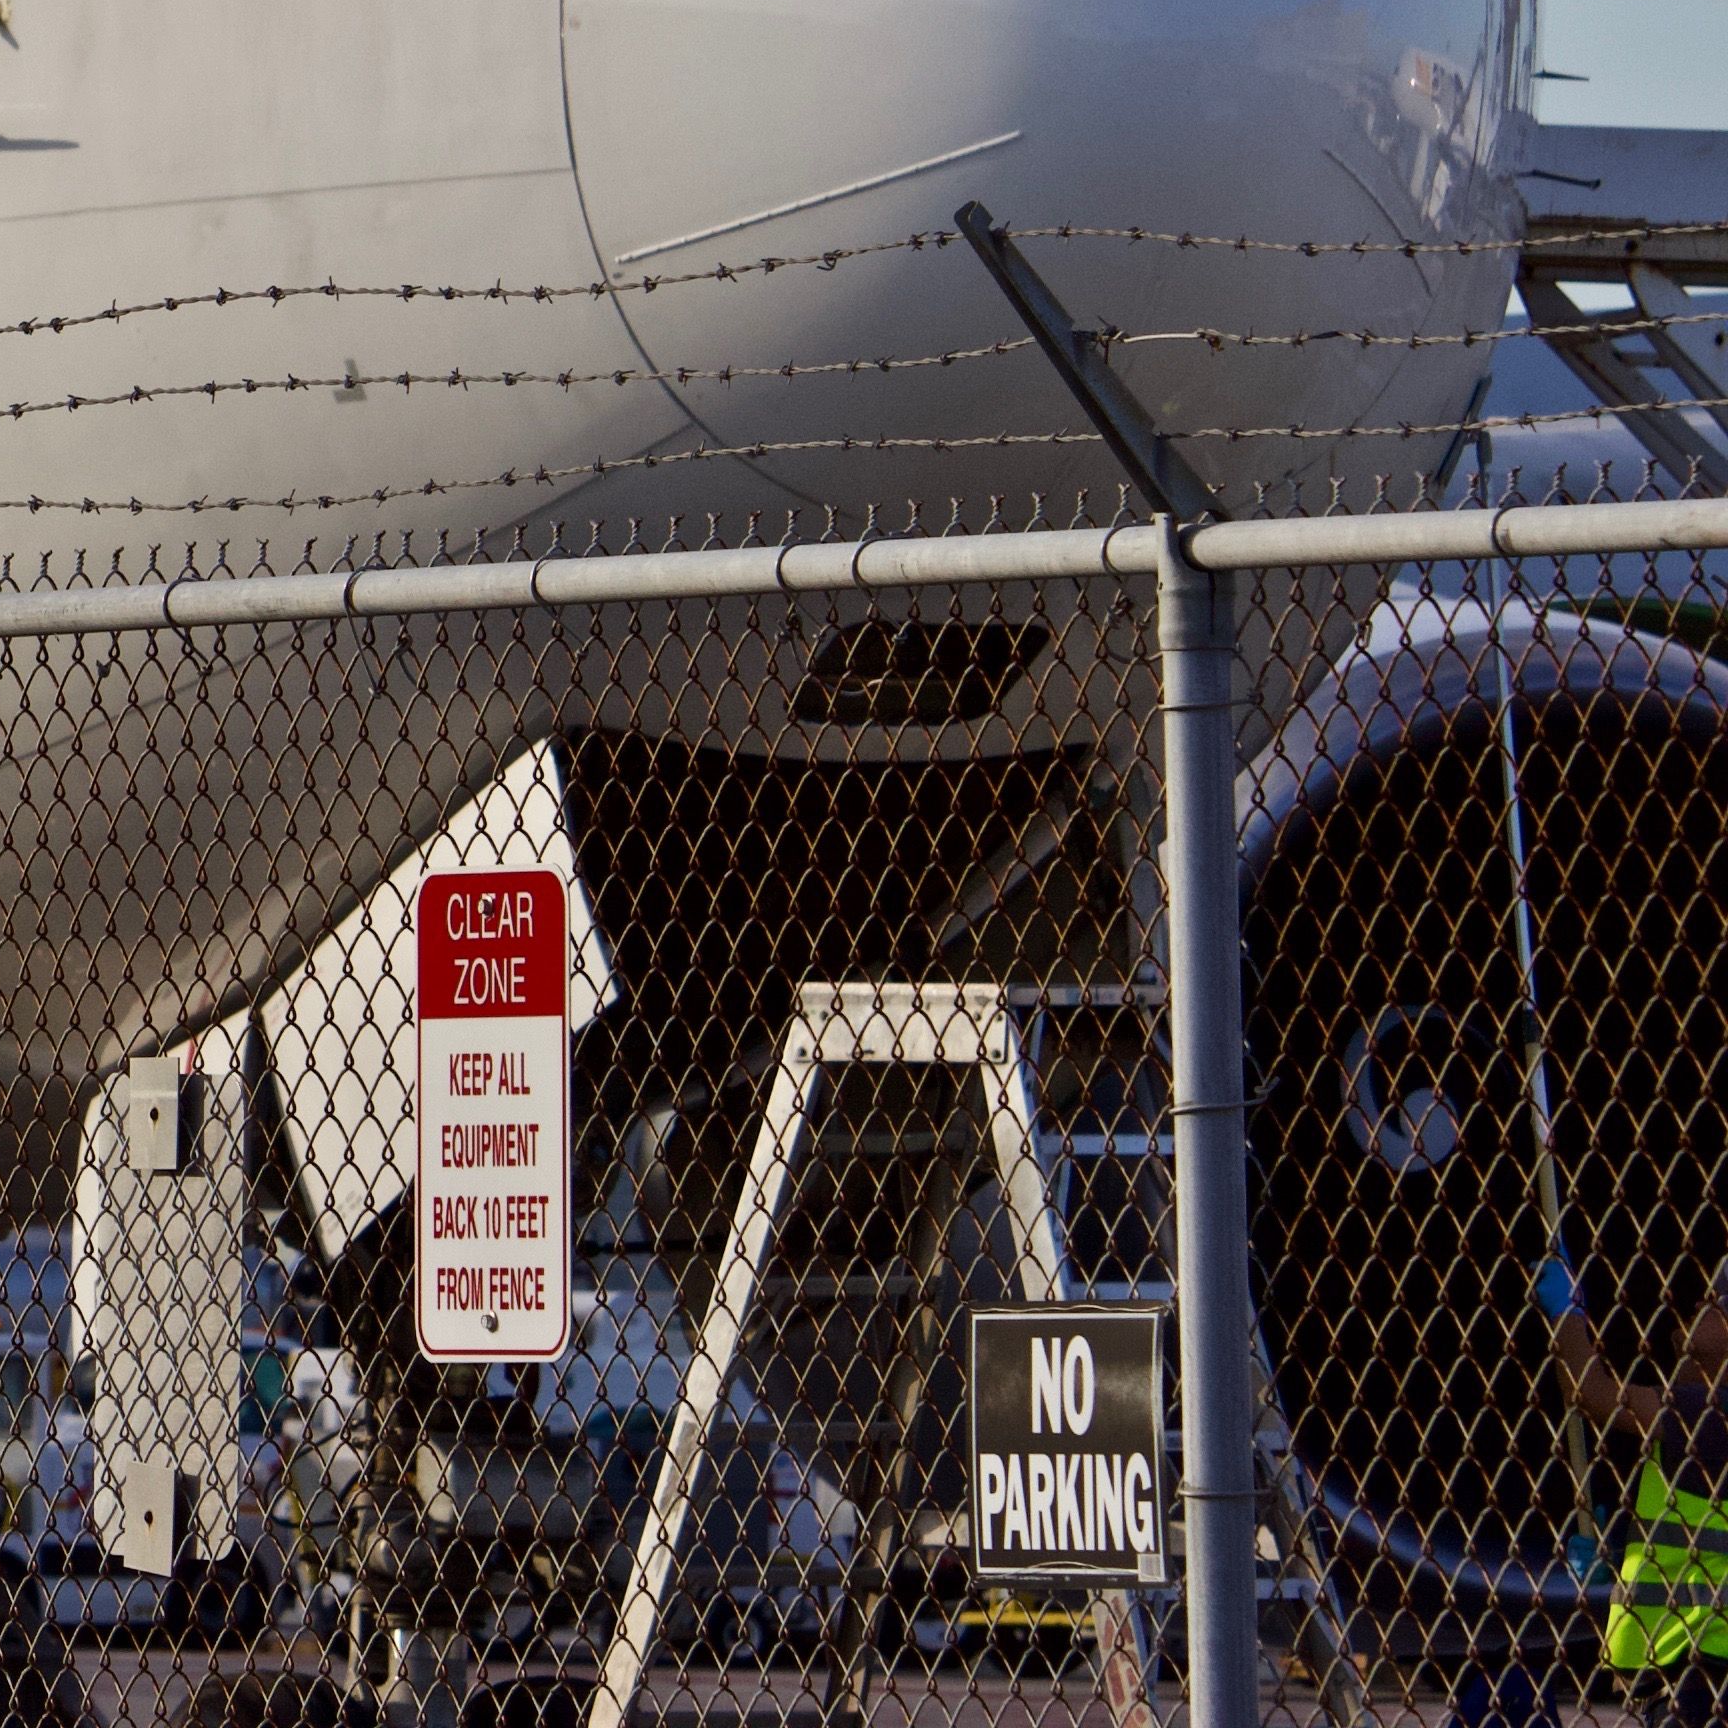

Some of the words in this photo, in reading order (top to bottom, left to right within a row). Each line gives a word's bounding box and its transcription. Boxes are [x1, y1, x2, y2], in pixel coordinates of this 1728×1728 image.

[447, 891, 534, 941] CLEAR
[454, 957, 526, 1005] ZONE
[449, 1053, 493, 1096] KEEP
[498, 1052, 531, 1095] ALL
[442, 1124, 539, 1169] EQUIPMENT
[433, 1195, 478, 1239] BACK
[483, 1196, 501, 1239] 10
[506, 1196, 549, 1238] FEET
[437, 1267, 483, 1310] FROM
[489, 1266, 545, 1311] FENCE
[1031, 1335, 1094, 1436] NO
[979, 1452, 1155, 1553] PARKING
